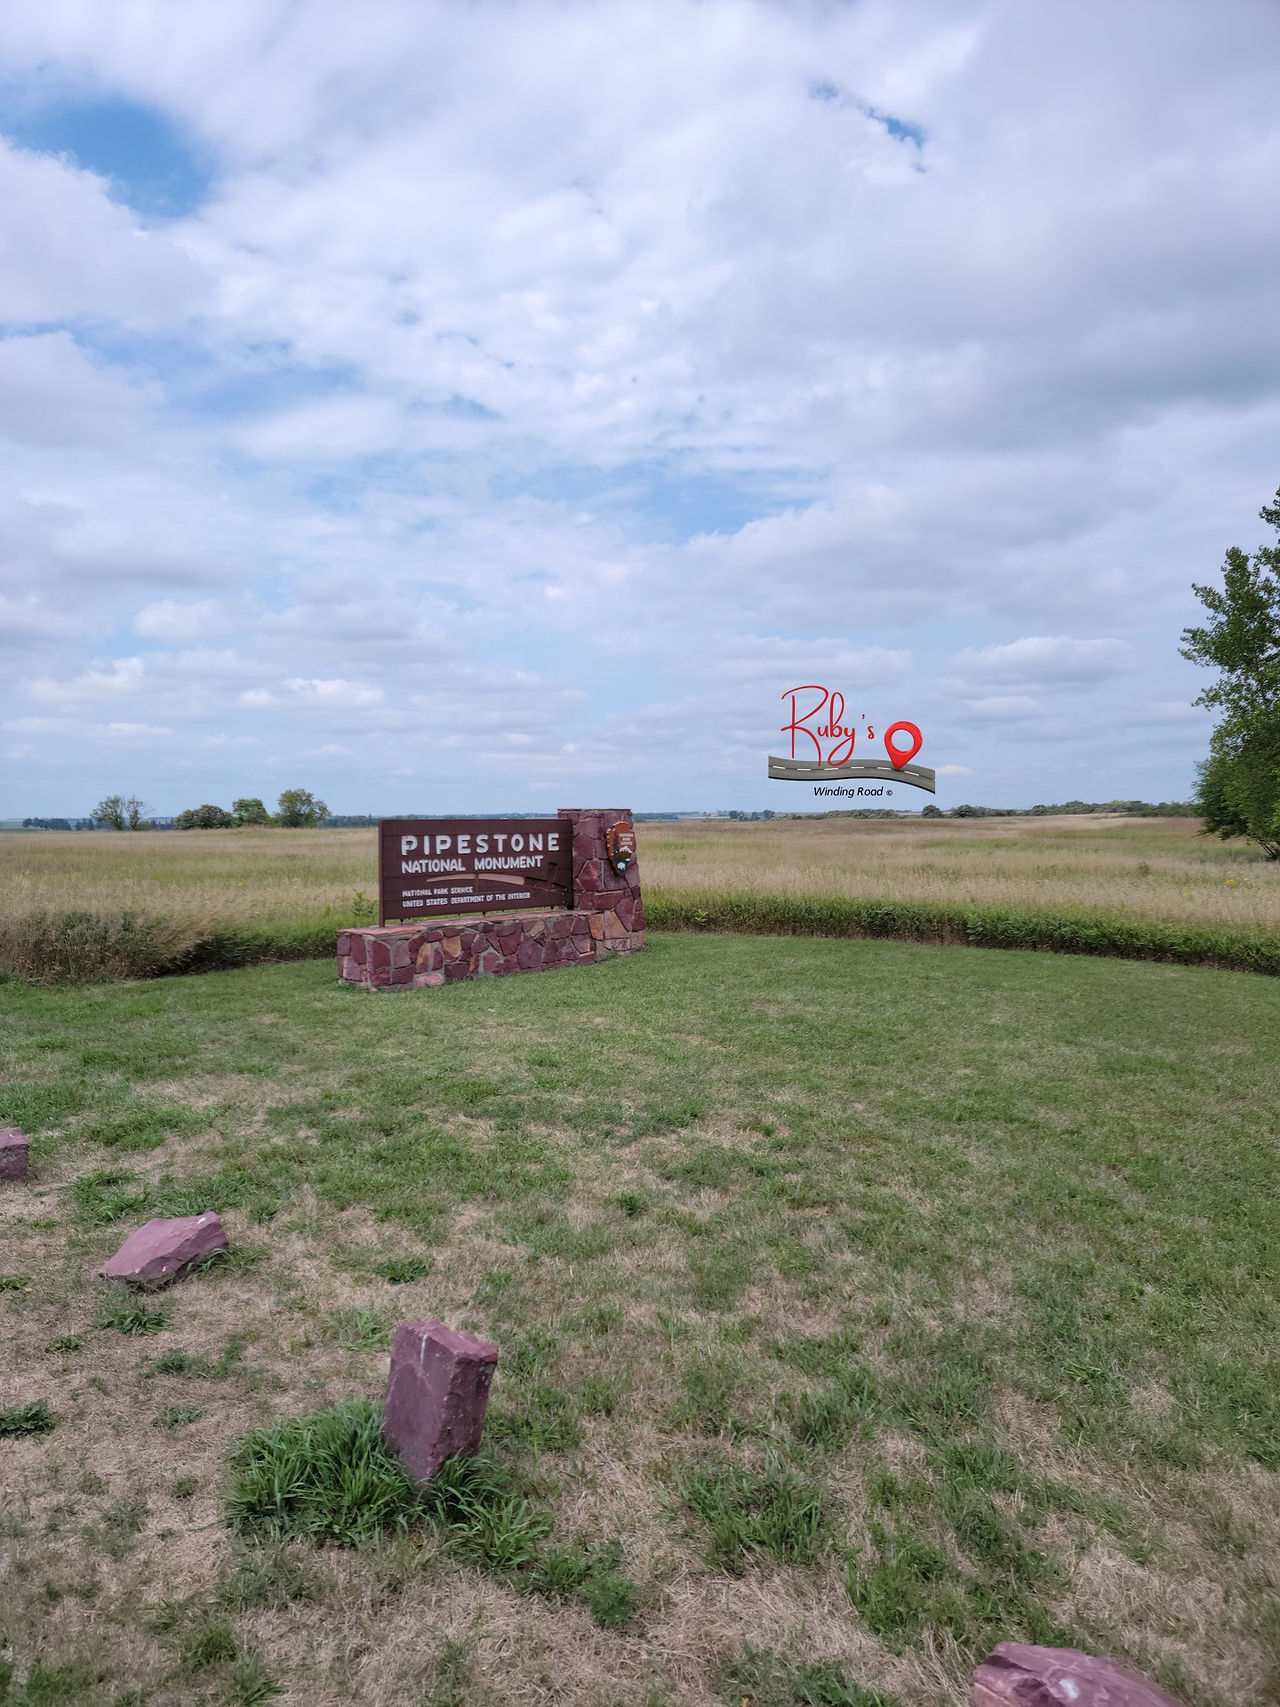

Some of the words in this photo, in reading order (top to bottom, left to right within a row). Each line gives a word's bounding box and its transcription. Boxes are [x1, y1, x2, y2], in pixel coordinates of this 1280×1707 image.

[401, 833, 560, 856] PIPESTONE
[401, 858, 466, 874] NATIONAL
[474, 855, 544, 870] MONUMENT
[402, 889, 432, 897] NATIONAL
[434, 887, 448, 895] PARK
[451, 886, 474, 894] SERVICE
[402, 899, 424, 908] UNITED
[426, 898, 448, 906] STATES
[451, 895, 484, 904] DEPARTMENT
[495, 893, 506, 901] THE
